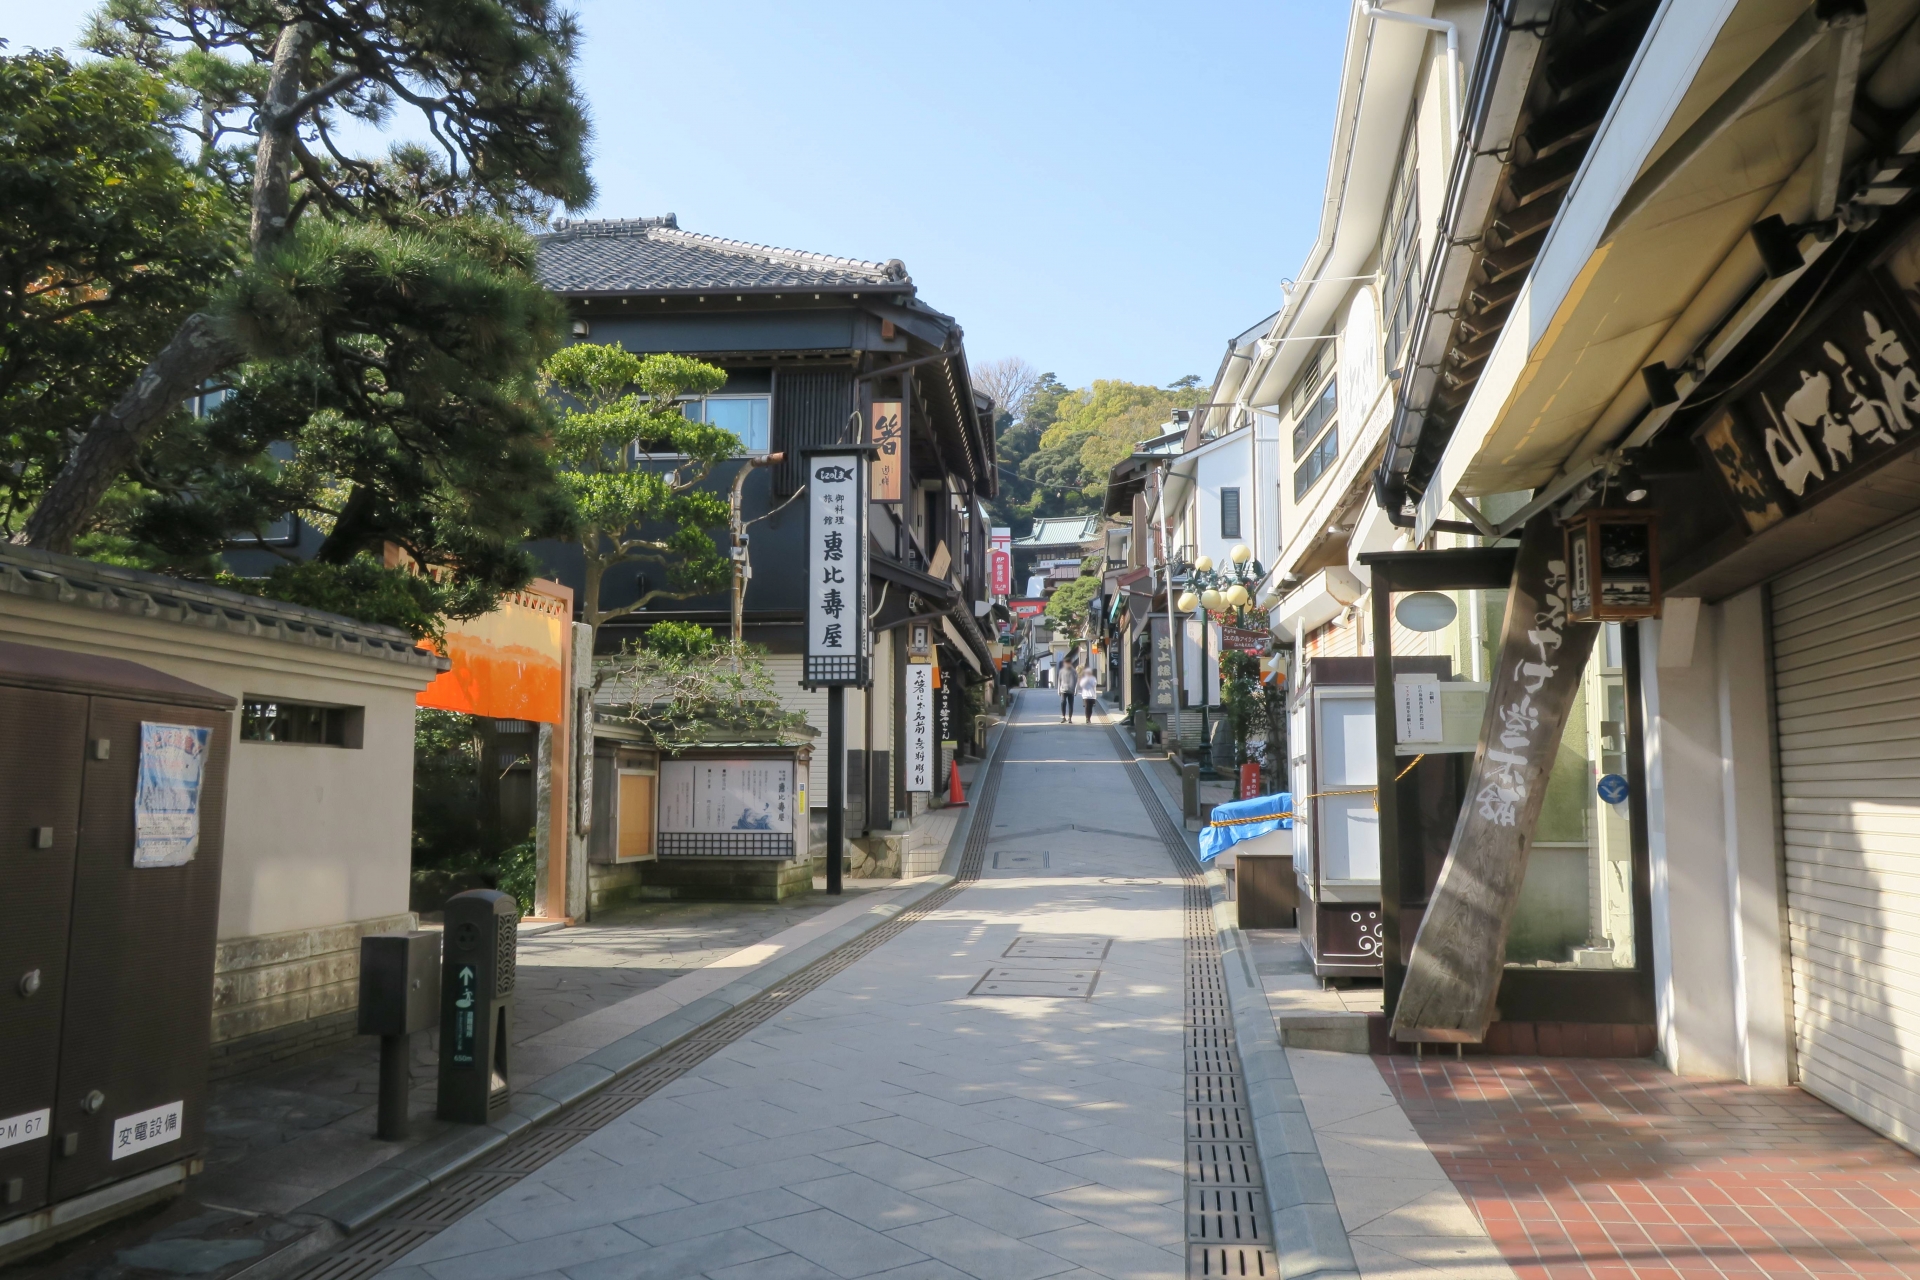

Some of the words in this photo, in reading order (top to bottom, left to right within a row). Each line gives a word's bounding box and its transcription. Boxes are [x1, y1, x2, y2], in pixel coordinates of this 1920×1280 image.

[873, 413, 901, 455] 箸
[823, 493, 834, 525] 旅館
[834, 493, 845, 525] 御料理
[453, 1054, 473, 1062] 650m
[25, 1117, 42, 1134] 67
[118, 1112, 178, 1149] 変電設備
